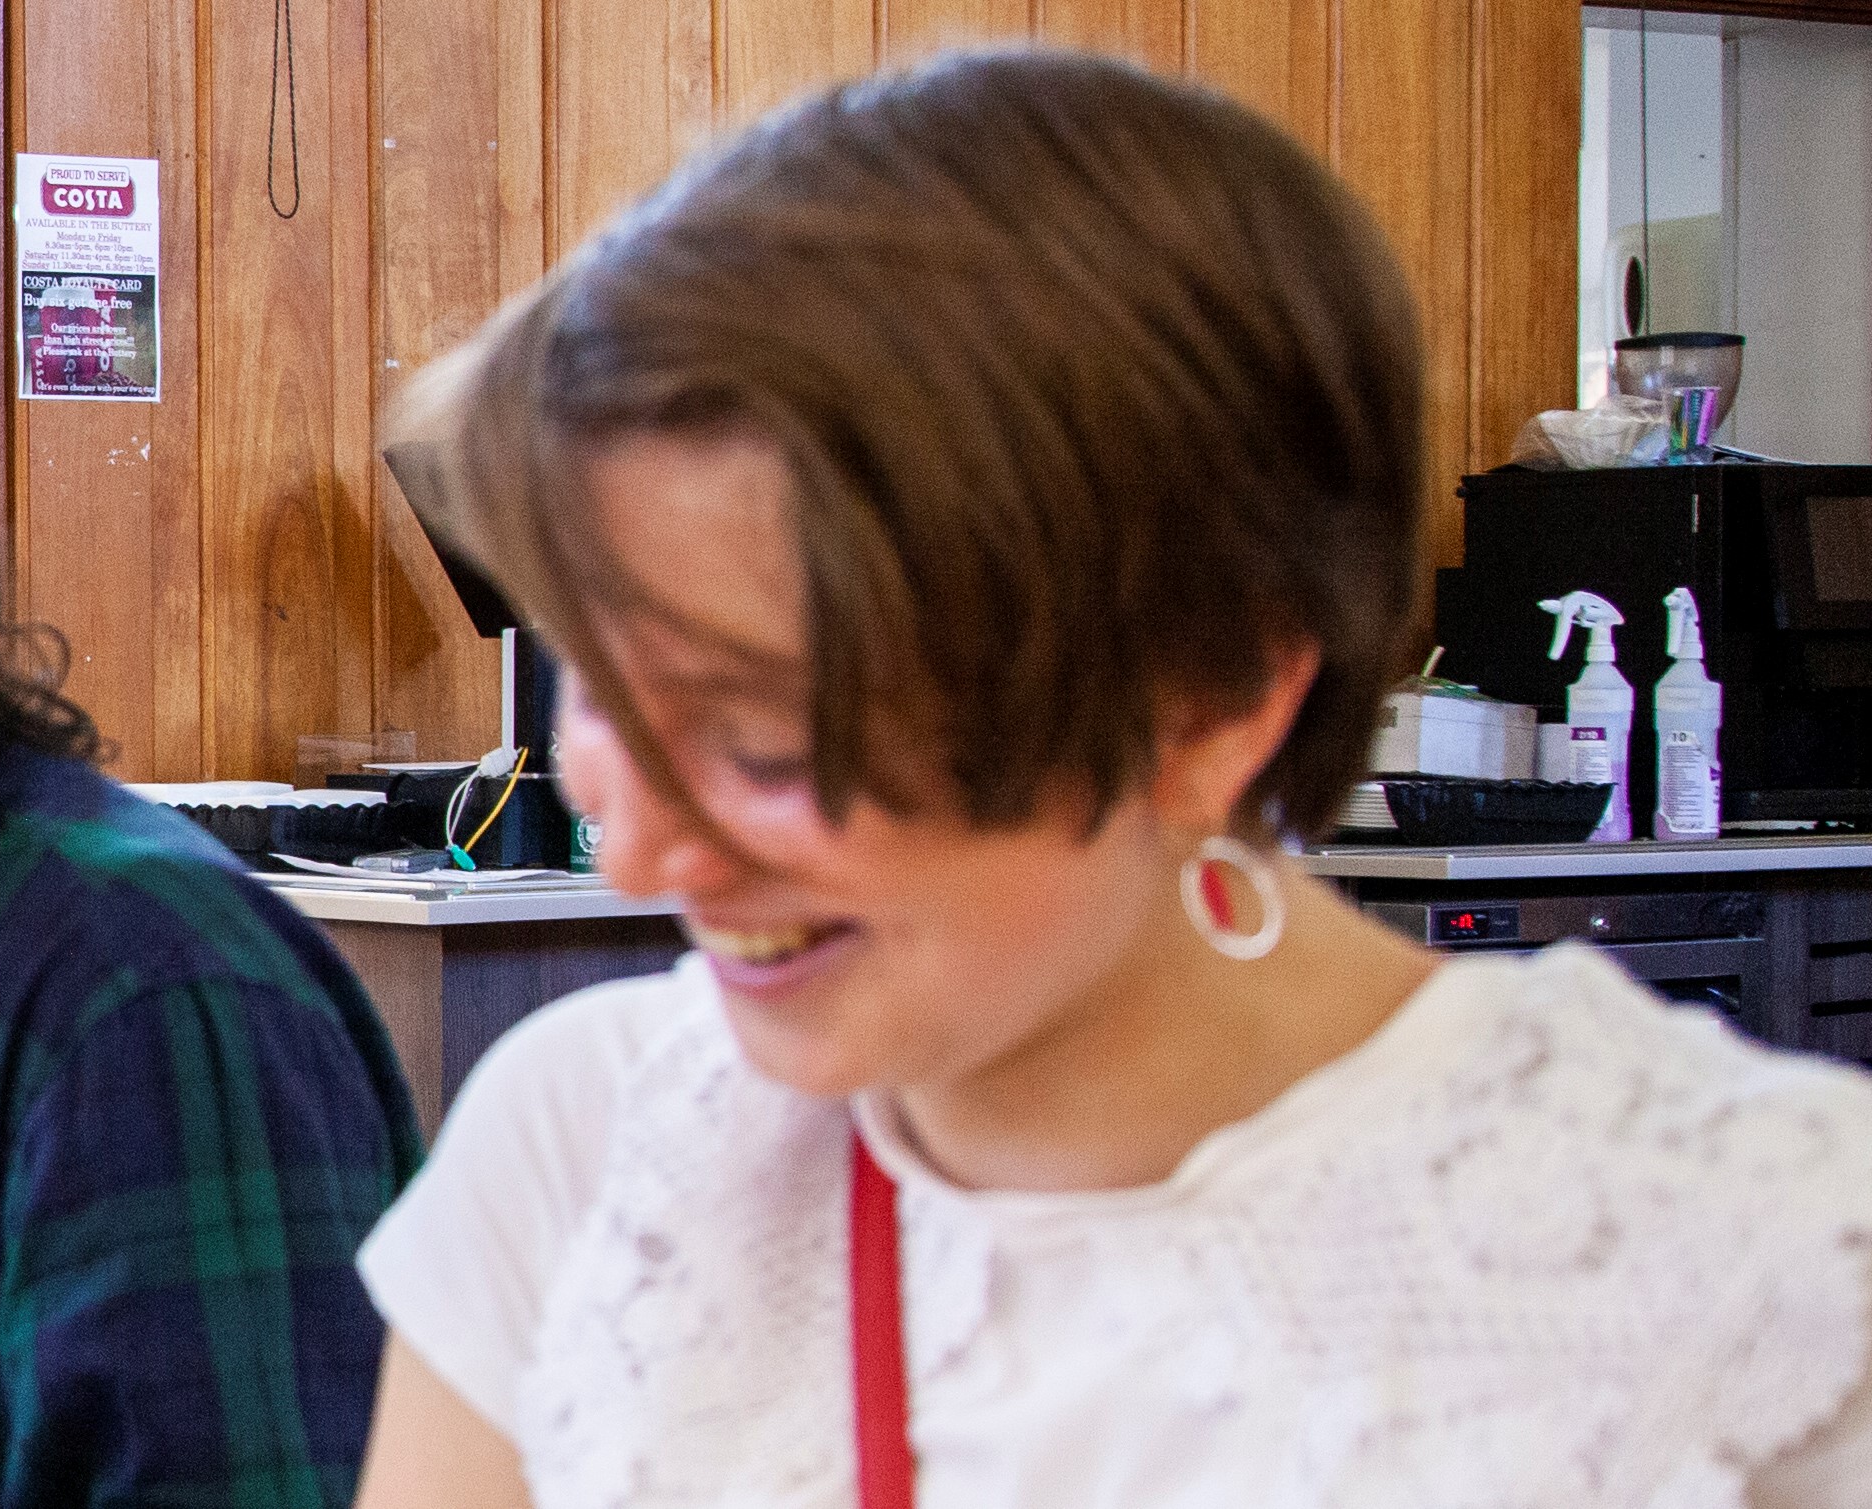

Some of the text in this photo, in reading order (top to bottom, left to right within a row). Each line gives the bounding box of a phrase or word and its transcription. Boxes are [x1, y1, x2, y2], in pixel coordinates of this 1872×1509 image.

[51, 169, 126, 182] PROUD TO SERVE
[53, 188, 124, 211] COSTA
[25, 218, 153, 232] AVAILABLE IN THE BUTTERY
[57, 232, 122, 243] Monday to Friday
[24, 250, 59, 260] Saturday
[22, 259, 50, 270] Sunday
[24, 276, 142, 291] COSTA LOYALTY CARD
[24, 293, 132, 310] Buy six get one free
